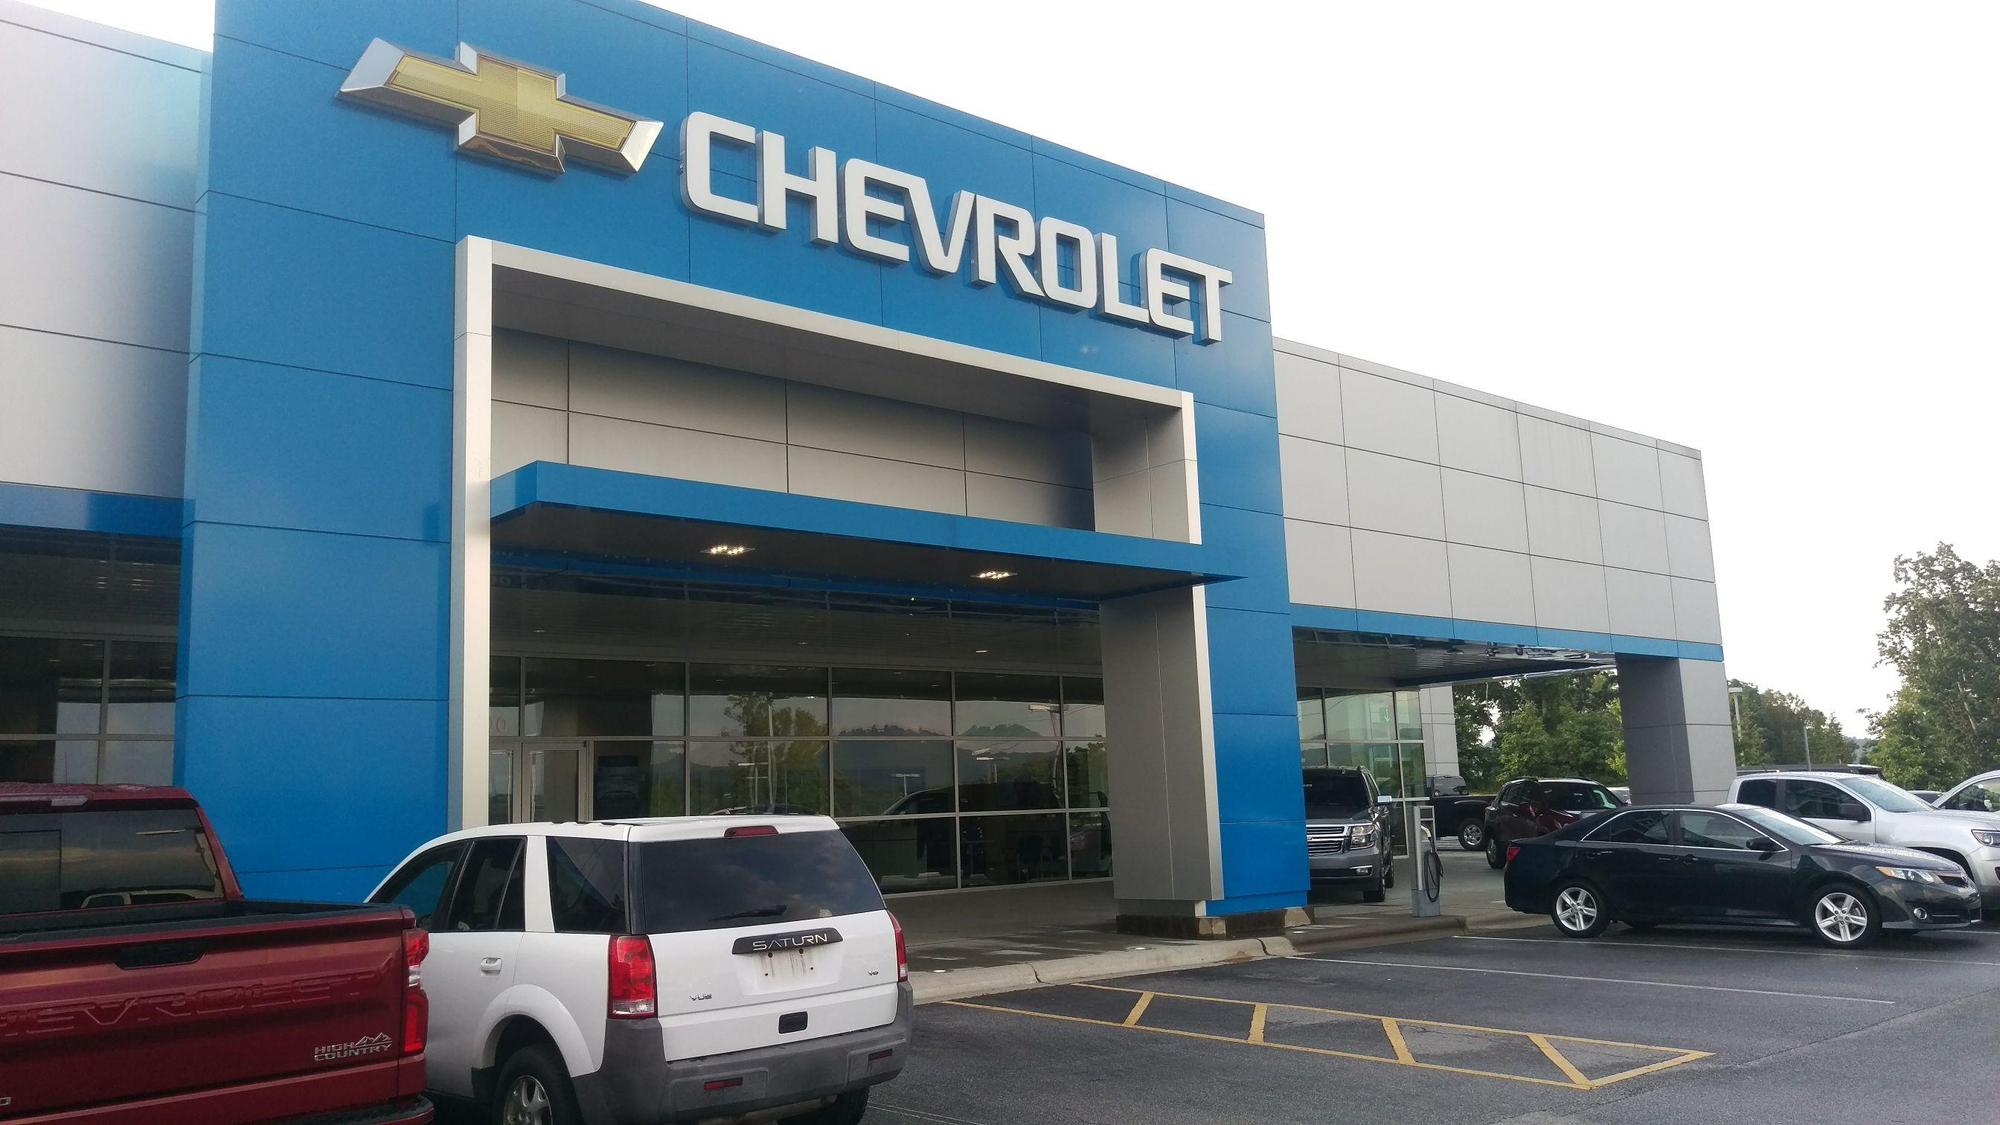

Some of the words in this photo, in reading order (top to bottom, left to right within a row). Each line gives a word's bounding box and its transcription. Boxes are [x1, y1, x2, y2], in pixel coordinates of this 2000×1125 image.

[681, 111, 1232, 343] CHEVROLET
[752, 933, 828, 951] SATURN
[314, 1043, 356, 1055] HIGH
[314, 1044, 392, 1062] COUNTRY
